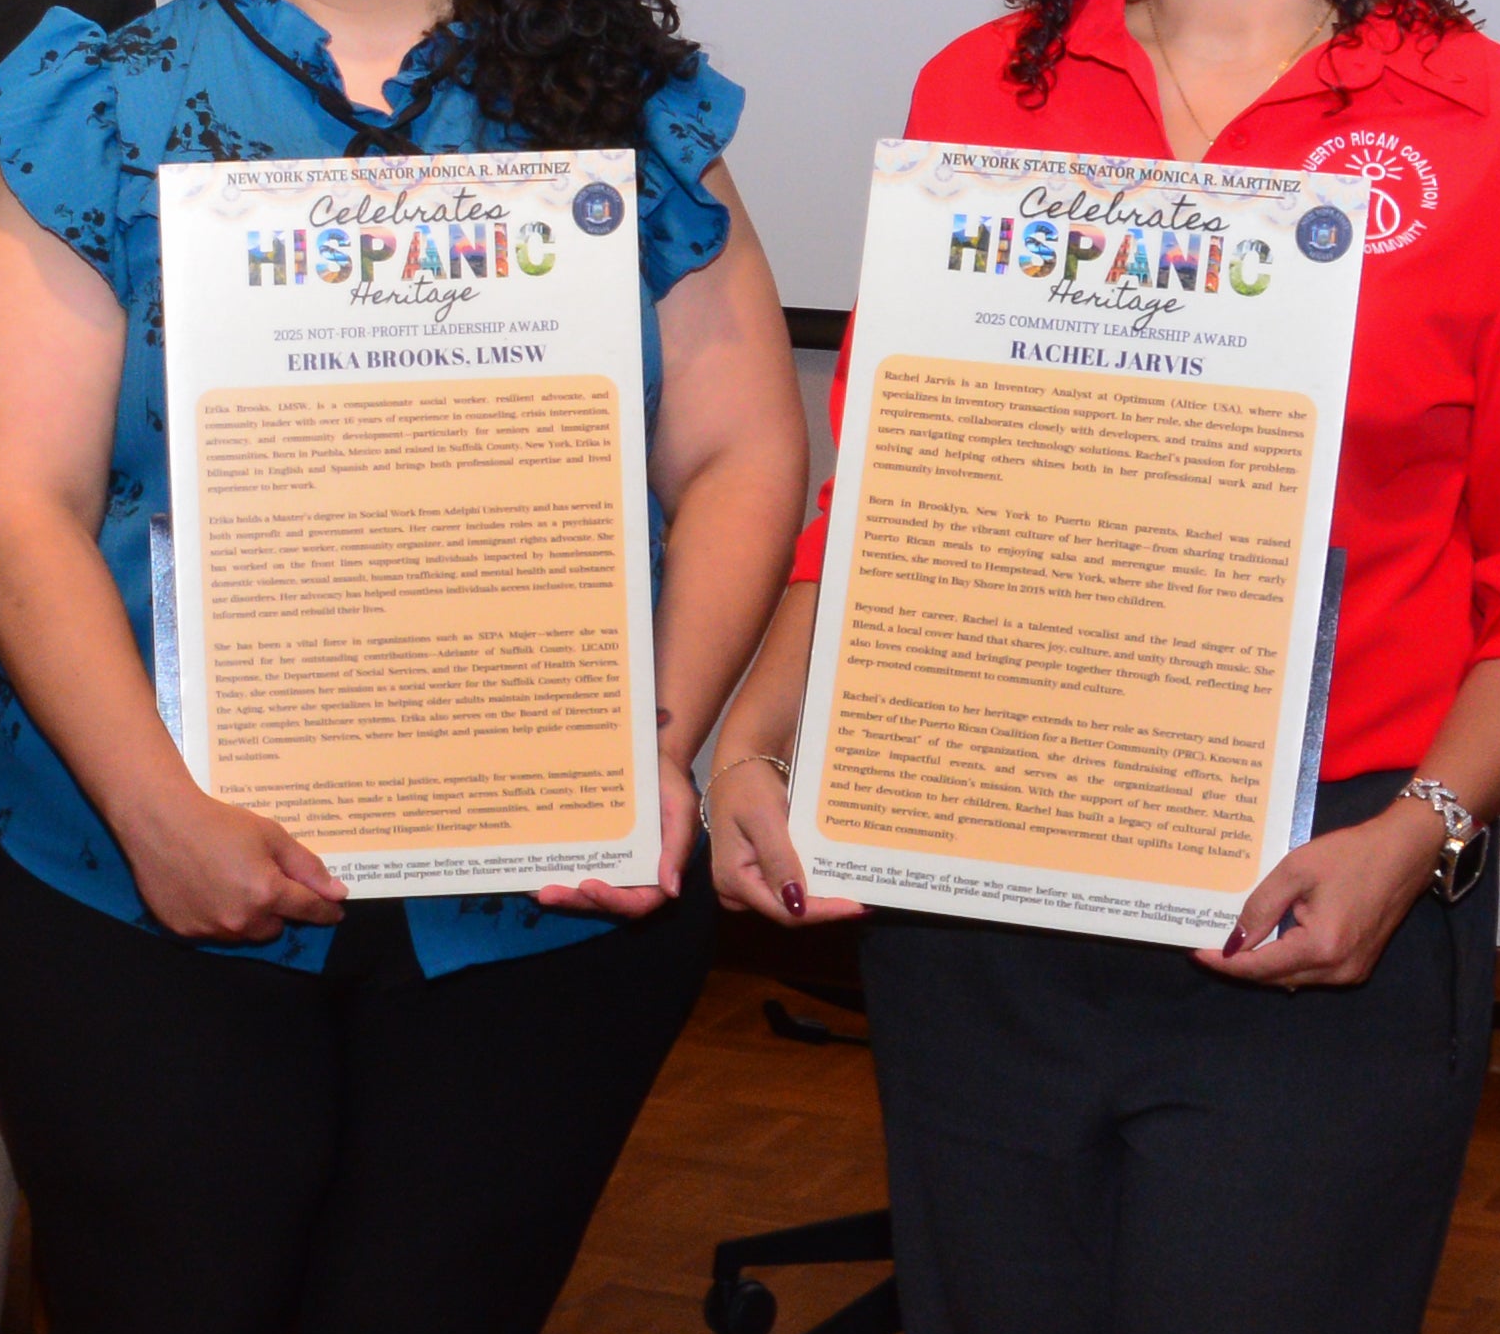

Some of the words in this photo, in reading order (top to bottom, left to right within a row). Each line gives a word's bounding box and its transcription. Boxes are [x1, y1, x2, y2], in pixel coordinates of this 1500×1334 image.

[227, 172, 260, 184] NEW
[264, 170, 303, 183] YORK
[306, 169, 348, 182] STATE
[350, 166, 414, 181] SENATOR
[418, 165, 476, 179] MONICA
[479, 164, 493, 176] R.
[496, 161, 571, 176] MARTINEZ
[941, 152, 978, 167] NEW
[979, 155, 1021, 169] YORK
[1022, 159, 1067, 174] STATE
[1067, 160, 1136, 180] SENATOR
[1137, 168, 1201, 185] MONICA
[1202, 173, 1218, 186] R.
[1220, 172, 1302, 193] MARTINEZ
[1302, 136, 1346, 172] UERTO
[1350, 130, 1400, 152] RICAN
[1401, 145, 1439, 211] COALITION
[309, 187, 510, 227] Celebrates
[1019, 186, 1231, 234] Celebrates
[247, 222, 556, 286] HISPANIC
[947, 214, 1275, 297] HISPANIC
[1364, 219, 1427, 255] OMMUNITY
[350, 275, 481, 322] Heritage
[1047, 278, 1185, 332] Heritage
[272, 329, 304, 341] 2025
[306, 324, 420, 340] NOT-FOR-PROFIT
[421, 321, 506, 335] LEADERSHIP
[507, 319, 560, 332] AWARD
[974, 311, 1006, 325] 2025
[1008, 315, 1100, 334] COMMUNITY
[1102, 322, 1191, 343] LEADERSHIP
[1192, 331, 1248, 348] AWARD
[287, 352, 362, 371] ERIKA
[474, 345, 547, 364] LMSW
[1009, 340, 1111, 367] RACHEL
[1113, 350, 1205, 376] JARVIS
